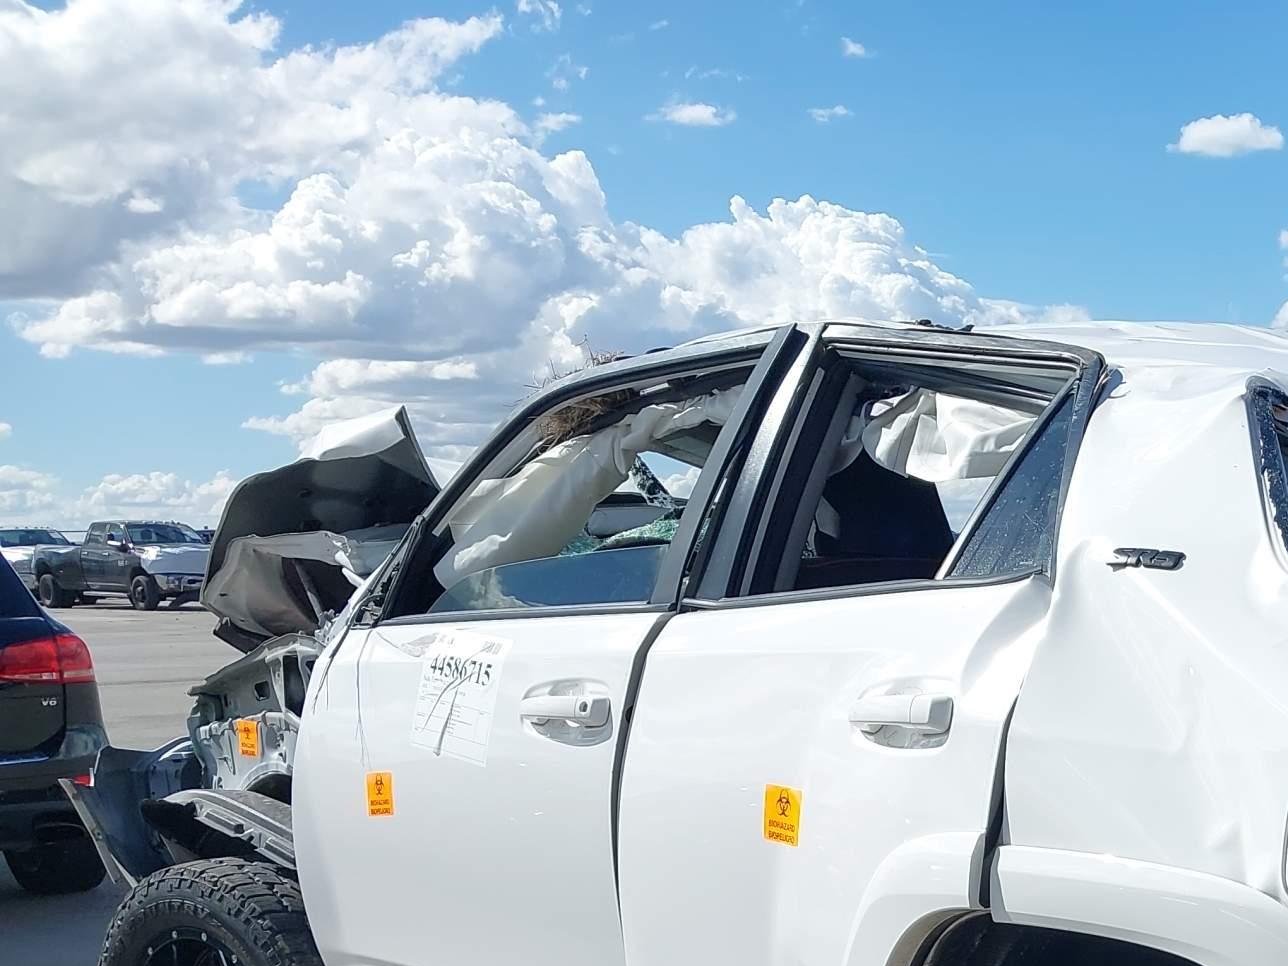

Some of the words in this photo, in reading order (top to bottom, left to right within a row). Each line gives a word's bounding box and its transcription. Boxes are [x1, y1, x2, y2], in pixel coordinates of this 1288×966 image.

[1106, 547, 1187, 572] SR5
[430, 655, 493, 686] 44586715
[41, 696, 57, 706] V6
